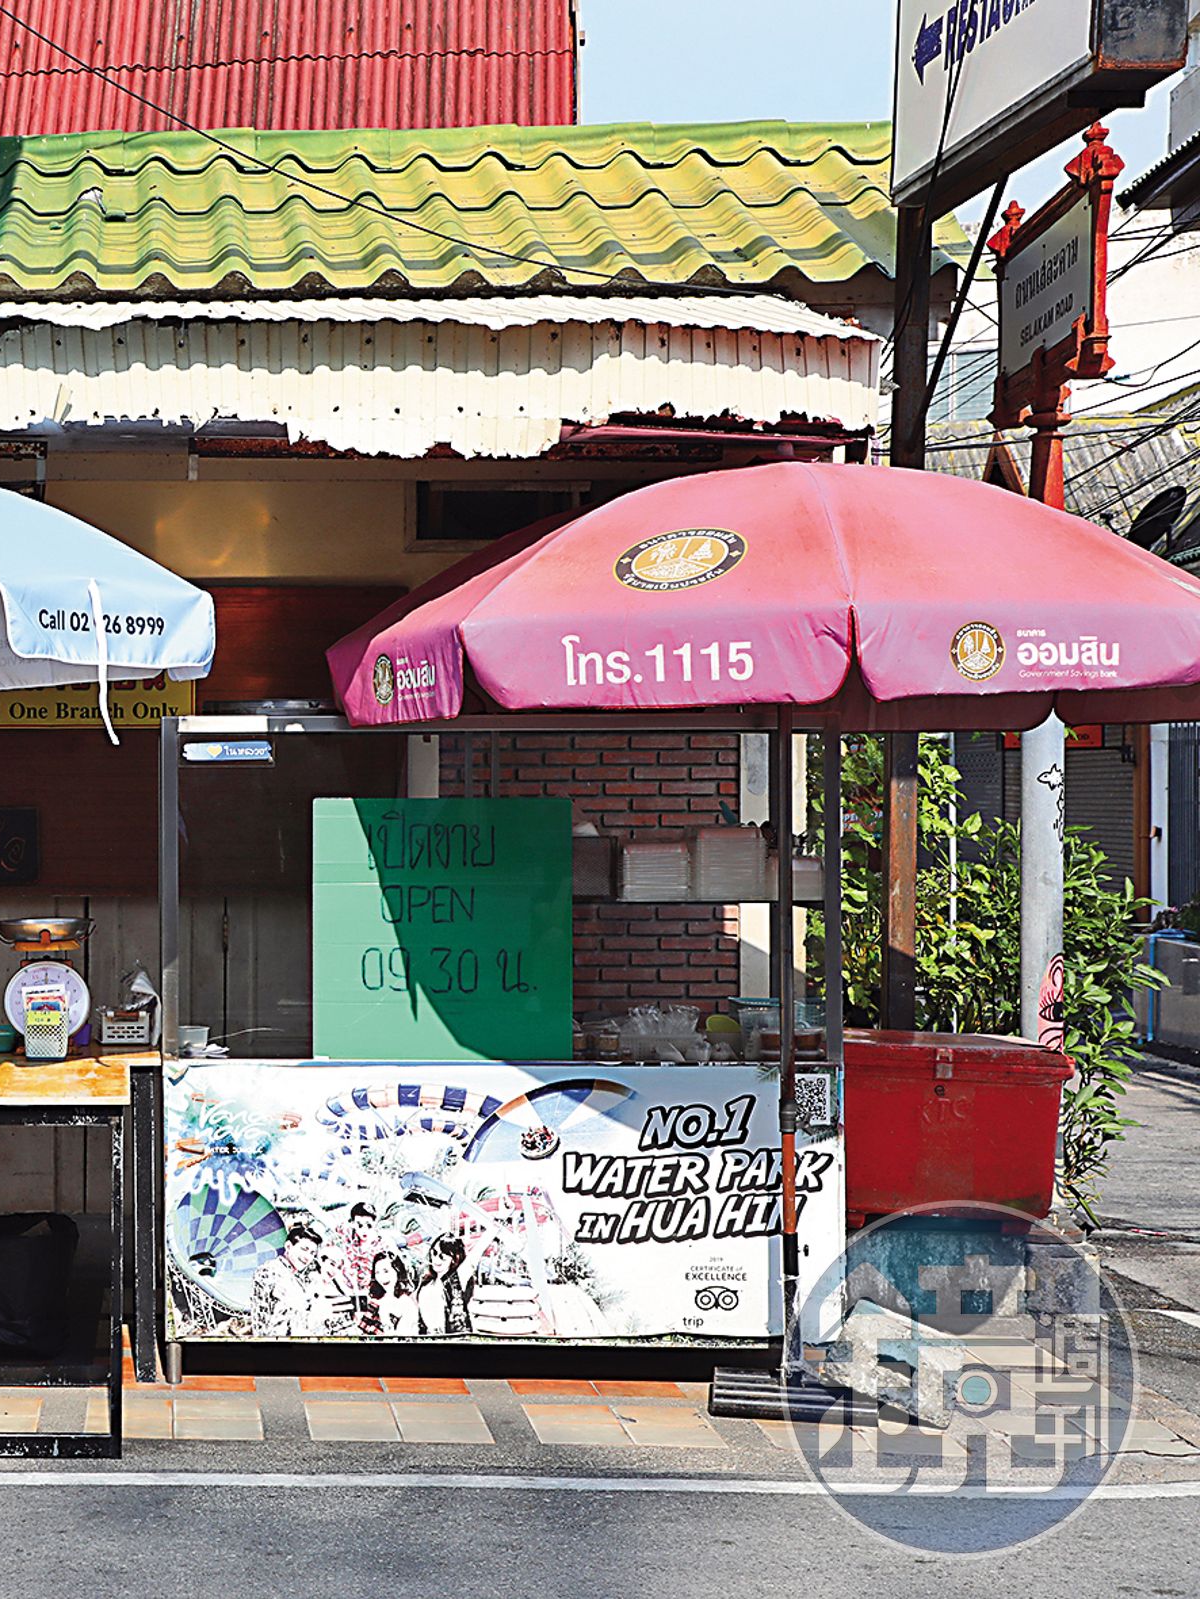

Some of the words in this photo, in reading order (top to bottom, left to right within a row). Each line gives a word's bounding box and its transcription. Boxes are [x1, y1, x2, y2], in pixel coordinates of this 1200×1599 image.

[1054, 292, 1073, 321] ROAD
[38, 608, 65, 631] Call
[69, 611, 90, 632] 02
[93, 614, 122, 635] 26
[125, 616, 165, 635] 8999
[561, 634, 754, 686] โทร.1115
[1016, 635, 1120, 666] ออมสิน
[1018, 669, 1069, 679] Government
[1100, 669, 1118, 678] Bank
[8, 702, 49, 720] One
[366, 808, 497, 871] เปิดขาย
[380, 884, 476, 925] OPEN
[639, 1095, 757, 1152] NO.1
[562, 1150, 711, 1199] WATER
[574, 1213, 621, 1243] IN
[617, 1195, 712, 1245] HUA
[685, 1272, 747, 1281] EXCELLENCE
[682, 1316, 704, 1328] trip
